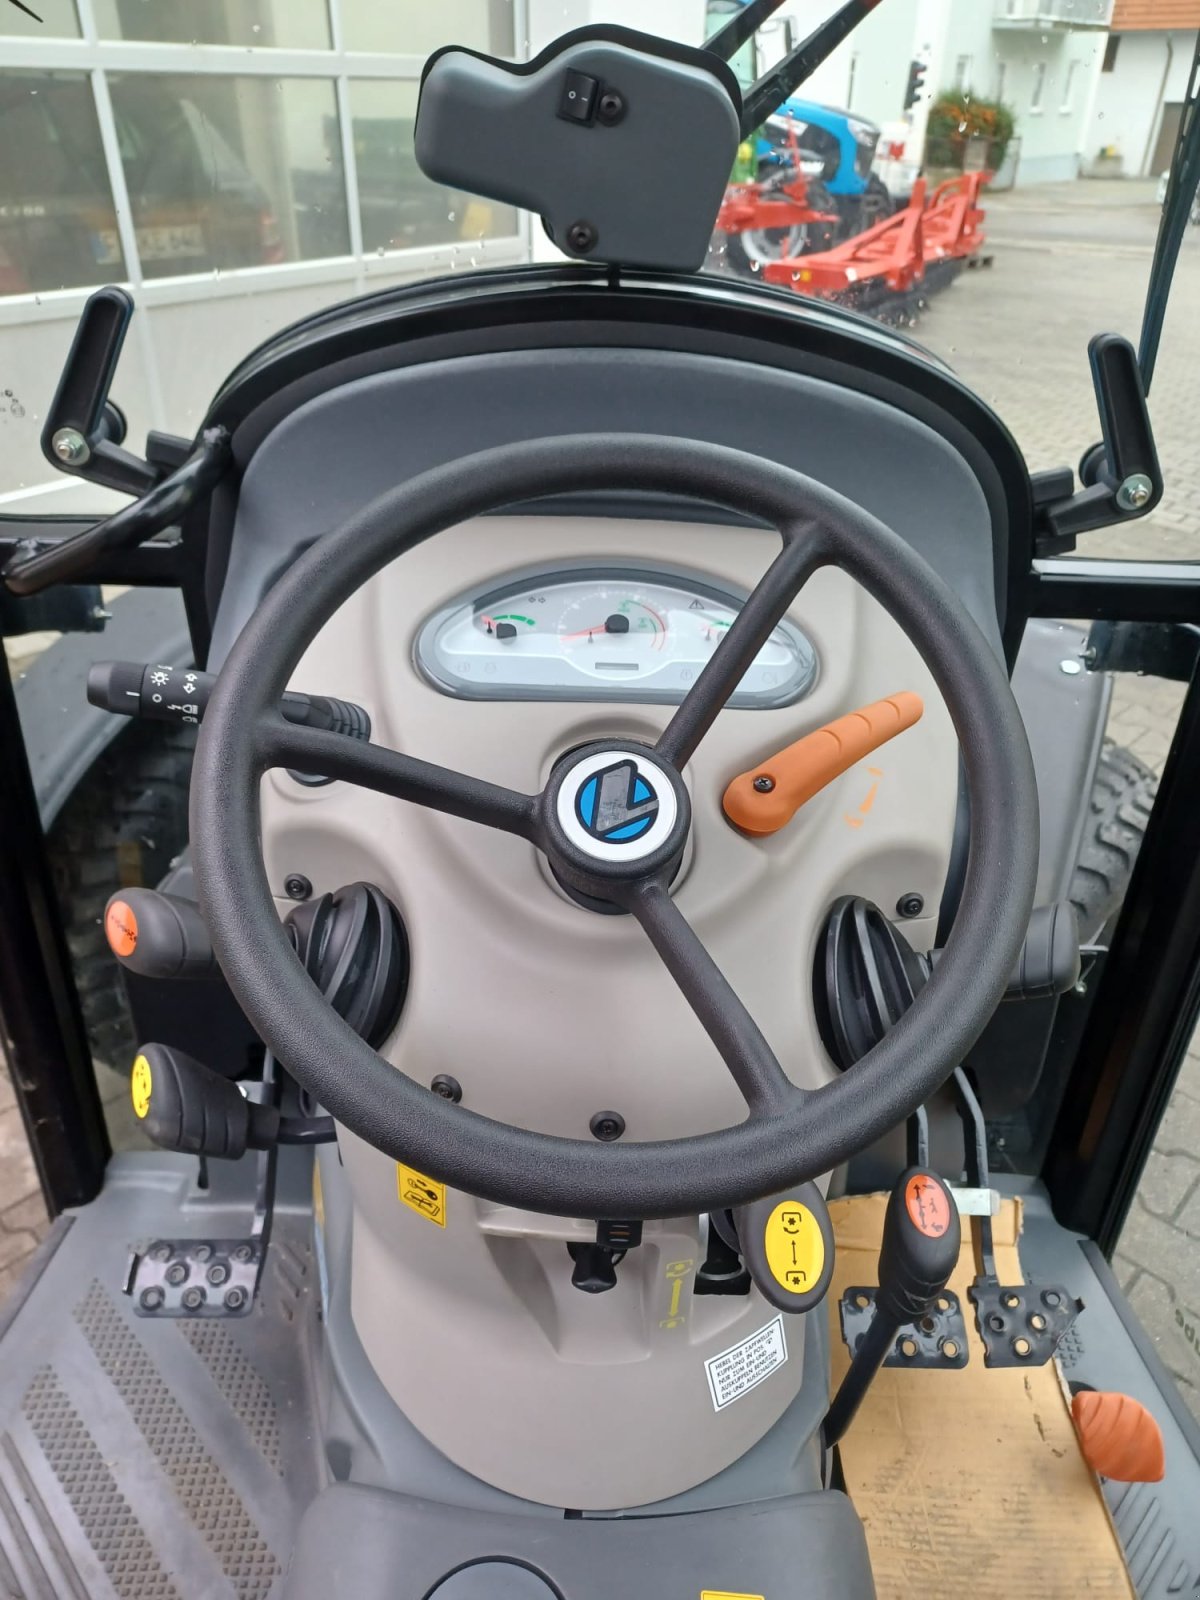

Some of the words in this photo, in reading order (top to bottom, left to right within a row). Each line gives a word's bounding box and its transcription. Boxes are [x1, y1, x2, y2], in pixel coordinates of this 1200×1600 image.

[715, 1357, 731, 1370] HEBEL
[732, 1350, 743, 1361] DER
[717, 1359, 745, 1378] KUPPLUNG
[746, 1353, 753, 1361] IN
[720, 1368, 753, 1392] AUSKUPPELN
[754, 1349, 778, 1371] BENUTZEN
[718, 1375, 731, 1385] NUR
[732, 1366, 745, 1377] ZUM
[721, 1382, 745, 1400] EIN-UND
[746, 1357, 778, 1384] AUSSCHALTEN
